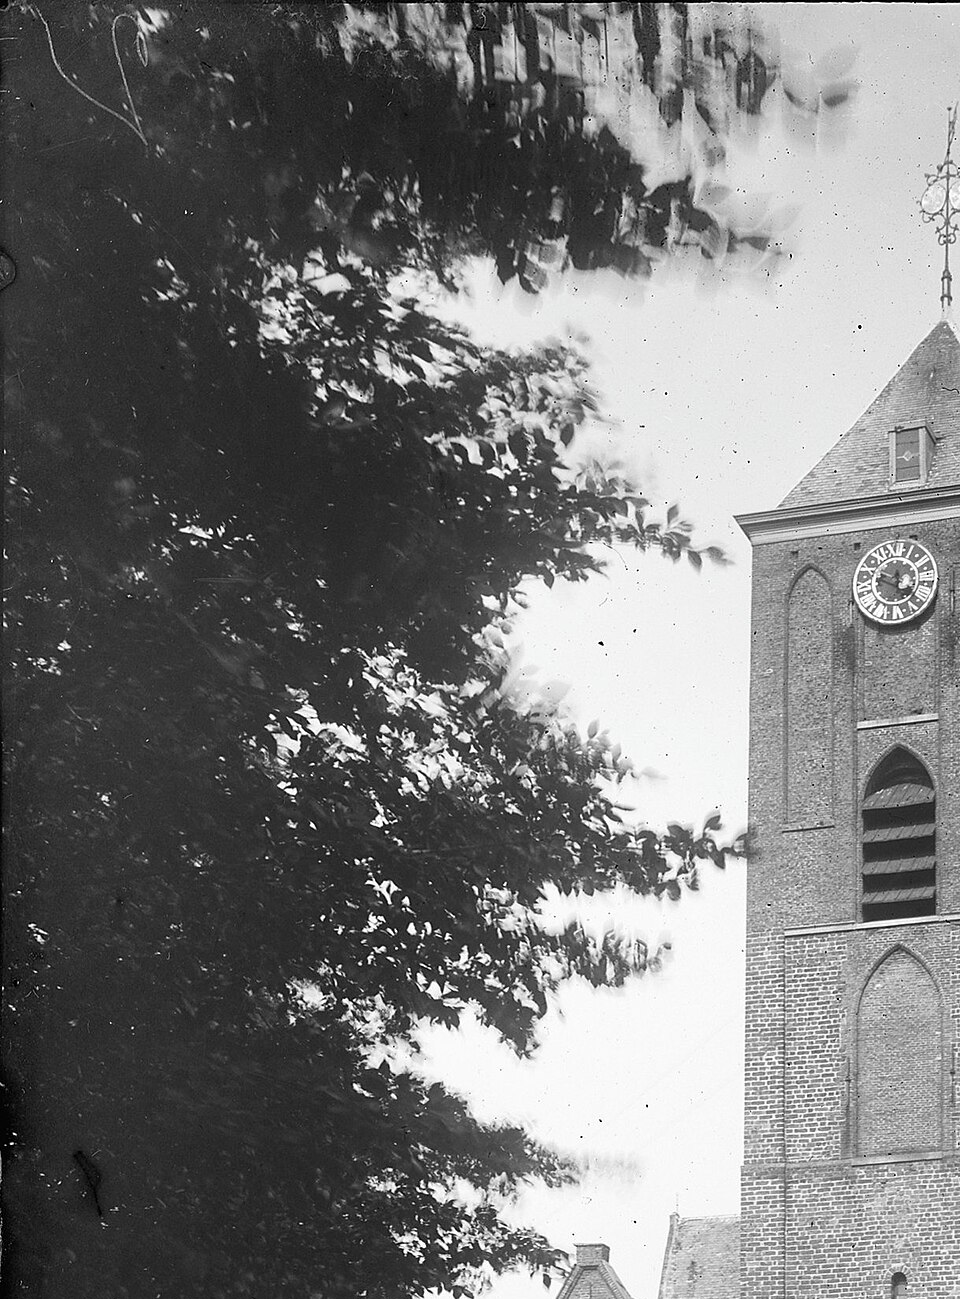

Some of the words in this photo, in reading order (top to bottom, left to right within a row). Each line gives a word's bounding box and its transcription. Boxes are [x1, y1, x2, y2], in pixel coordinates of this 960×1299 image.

[871, 548, 888, 564] XI
[886, 543, 904, 556] XII
[906, 545, 914, 558] I
[915, 555, 929, 567] II
[860, 563, 876, 575] X
[919, 570, 933, 581] III
[857, 580, 871, 593] IX
[892, 606, 903, 619] VI
[908, 602, 918, 614] V
